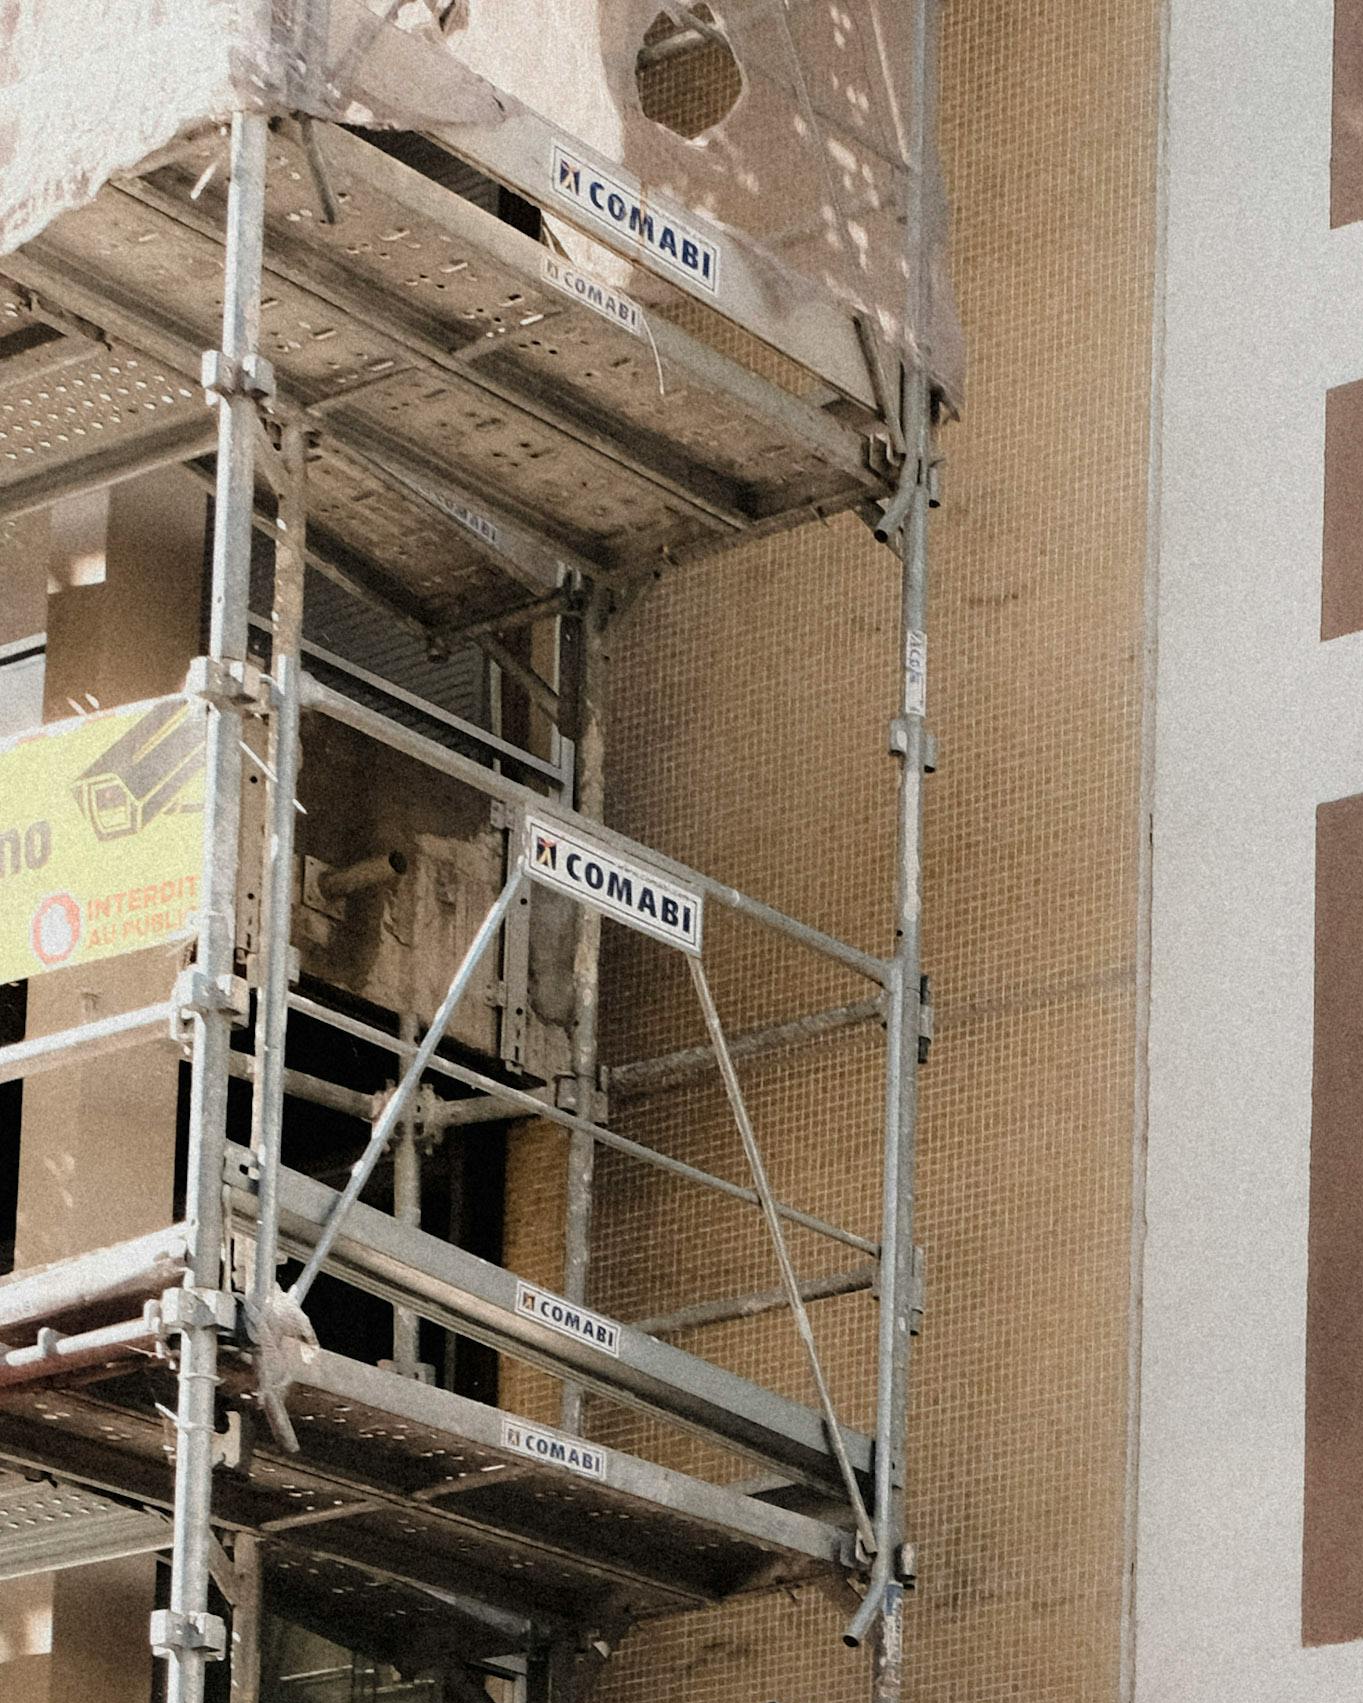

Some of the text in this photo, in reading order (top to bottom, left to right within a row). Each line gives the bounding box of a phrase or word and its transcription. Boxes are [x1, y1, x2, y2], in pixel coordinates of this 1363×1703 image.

[588, 181, 711, 279] COMABI
[563, 271, 637, 326] COMABI
[86, 874, 200, 921] INTERDIT
[565, 852, 692, 934] COMABI
[86, 925, 117, 950] AU
[539, 1300, 614, 1348] COMABI
[524, 1434, 601, 1473] COMABI
